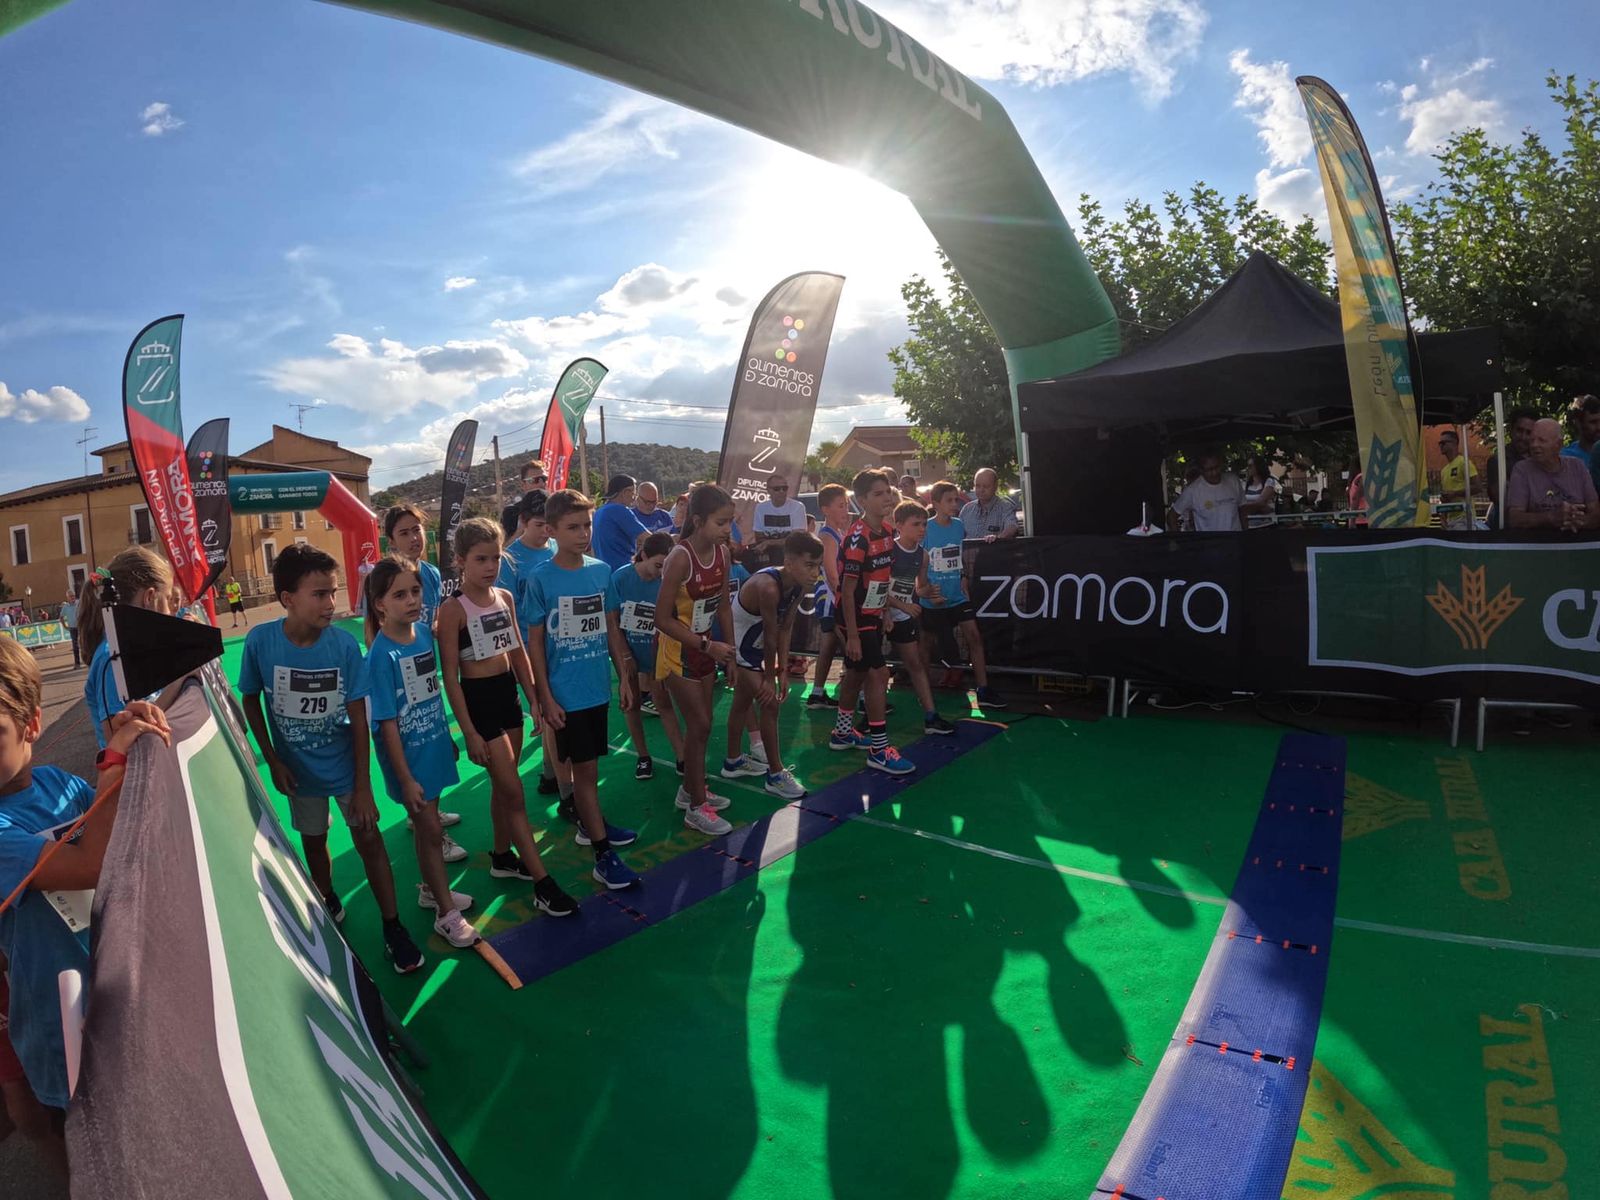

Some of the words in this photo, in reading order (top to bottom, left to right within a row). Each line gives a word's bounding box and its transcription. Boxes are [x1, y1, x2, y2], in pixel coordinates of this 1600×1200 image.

[737, 477, 768, 490] DIPUTAC
[731, 488, 771, 503] ZAMO
[975, 572, 1230, 635] zamora
[581, 616, 600, 633] 260
[636, 619, 654, 632] 250
[493, 632, 512, 650] 254
[426, 675, 438, 693] 30
[300, 696, 327, 714] 279
